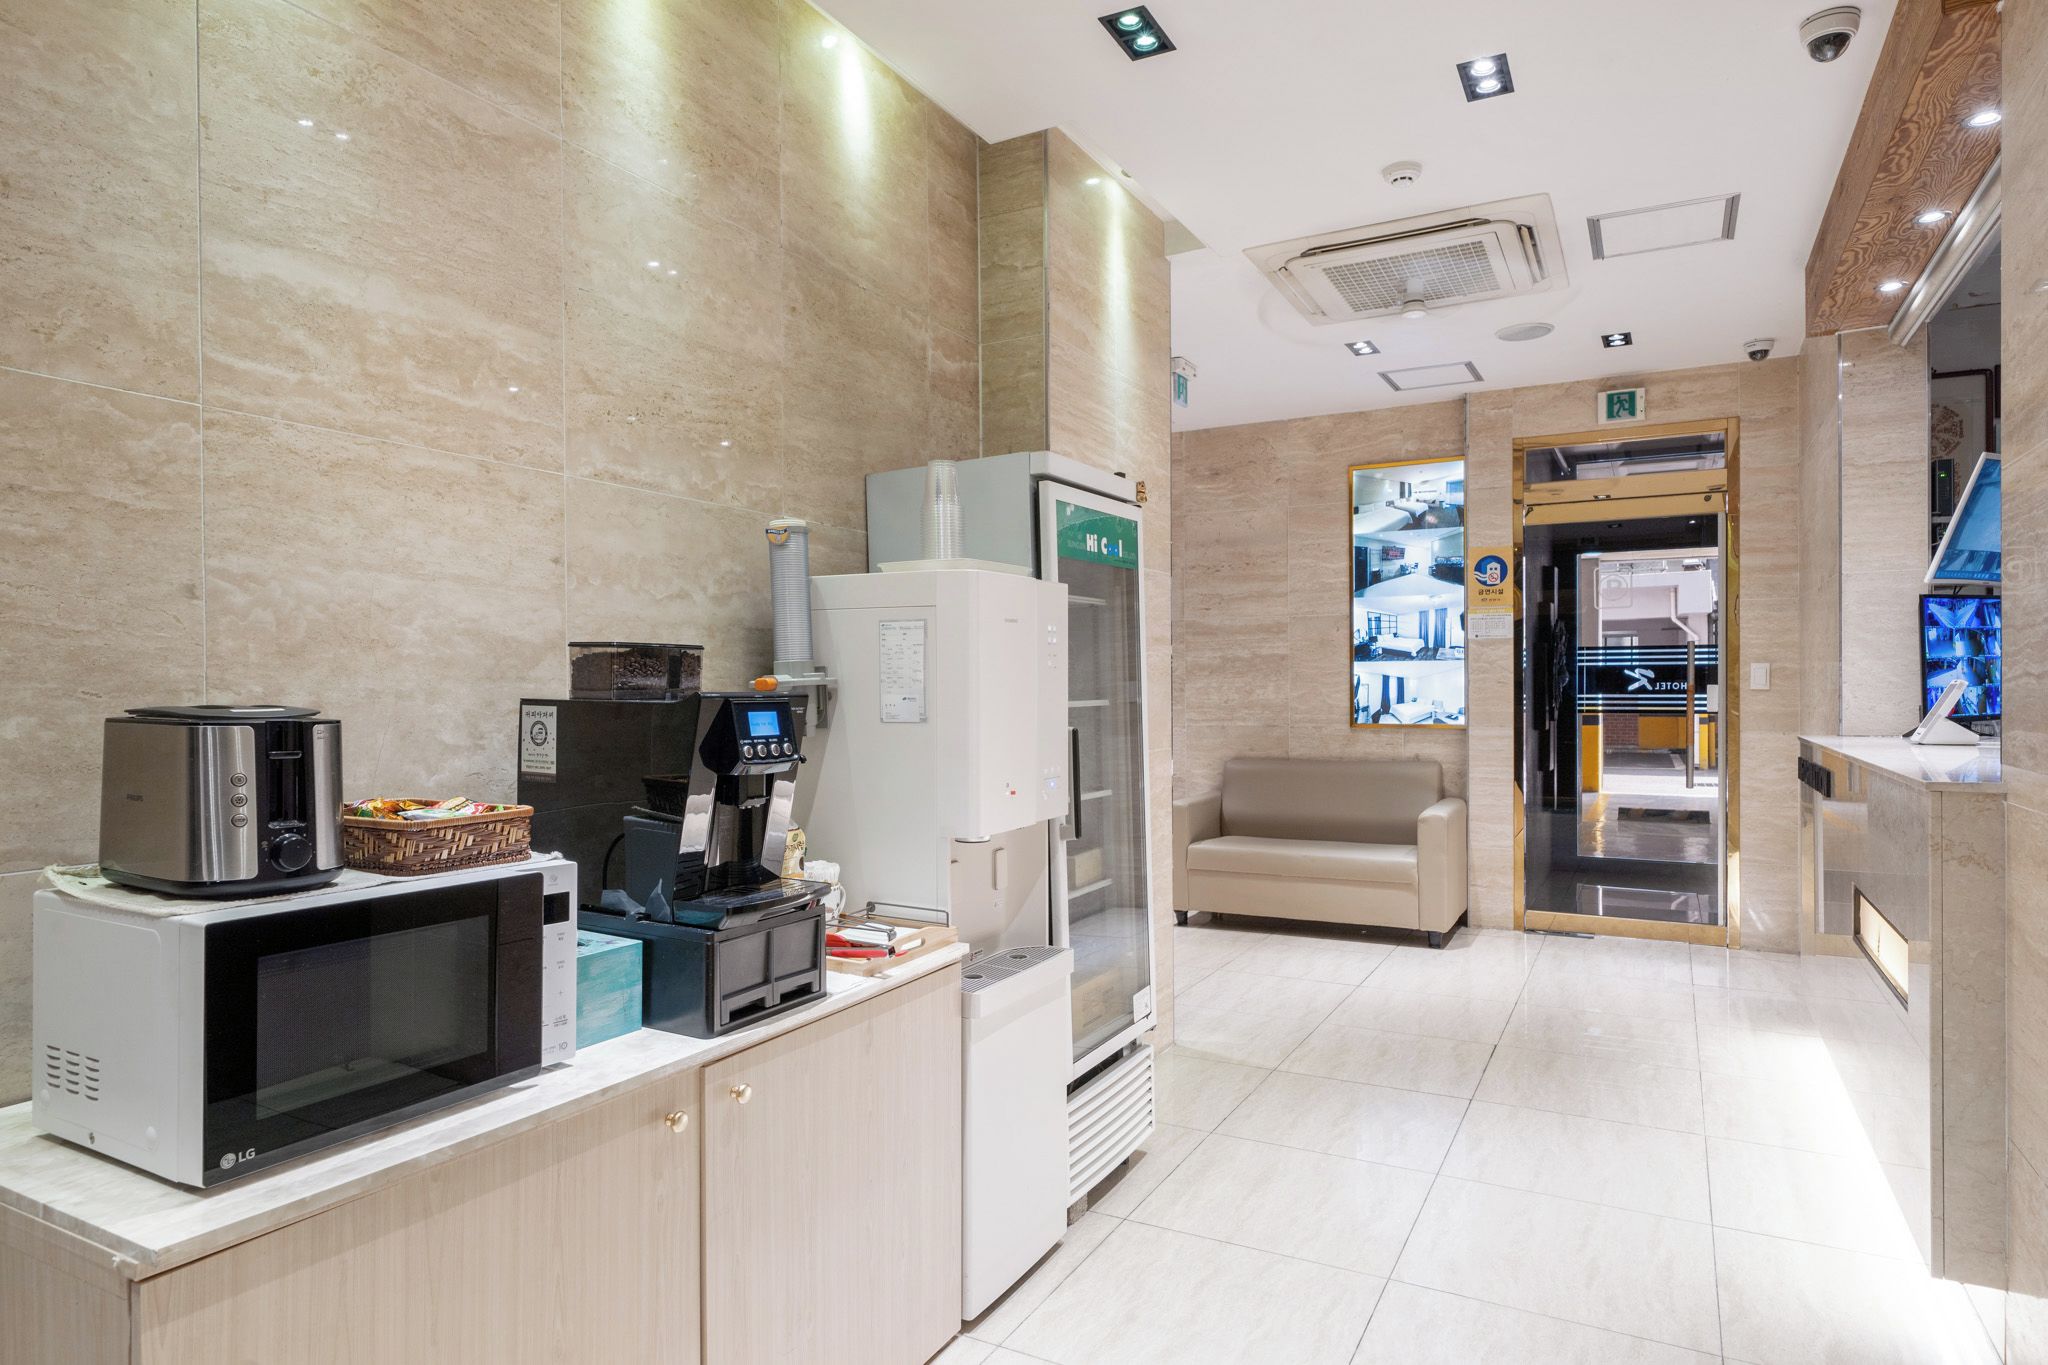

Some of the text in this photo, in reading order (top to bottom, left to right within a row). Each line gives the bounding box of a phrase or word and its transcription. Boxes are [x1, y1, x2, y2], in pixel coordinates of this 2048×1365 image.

[1086, 534, 1097, 552] Hi
[1478, 588, 1504, 596] 금연시설
[238, 1148, 256, 1162] LG
